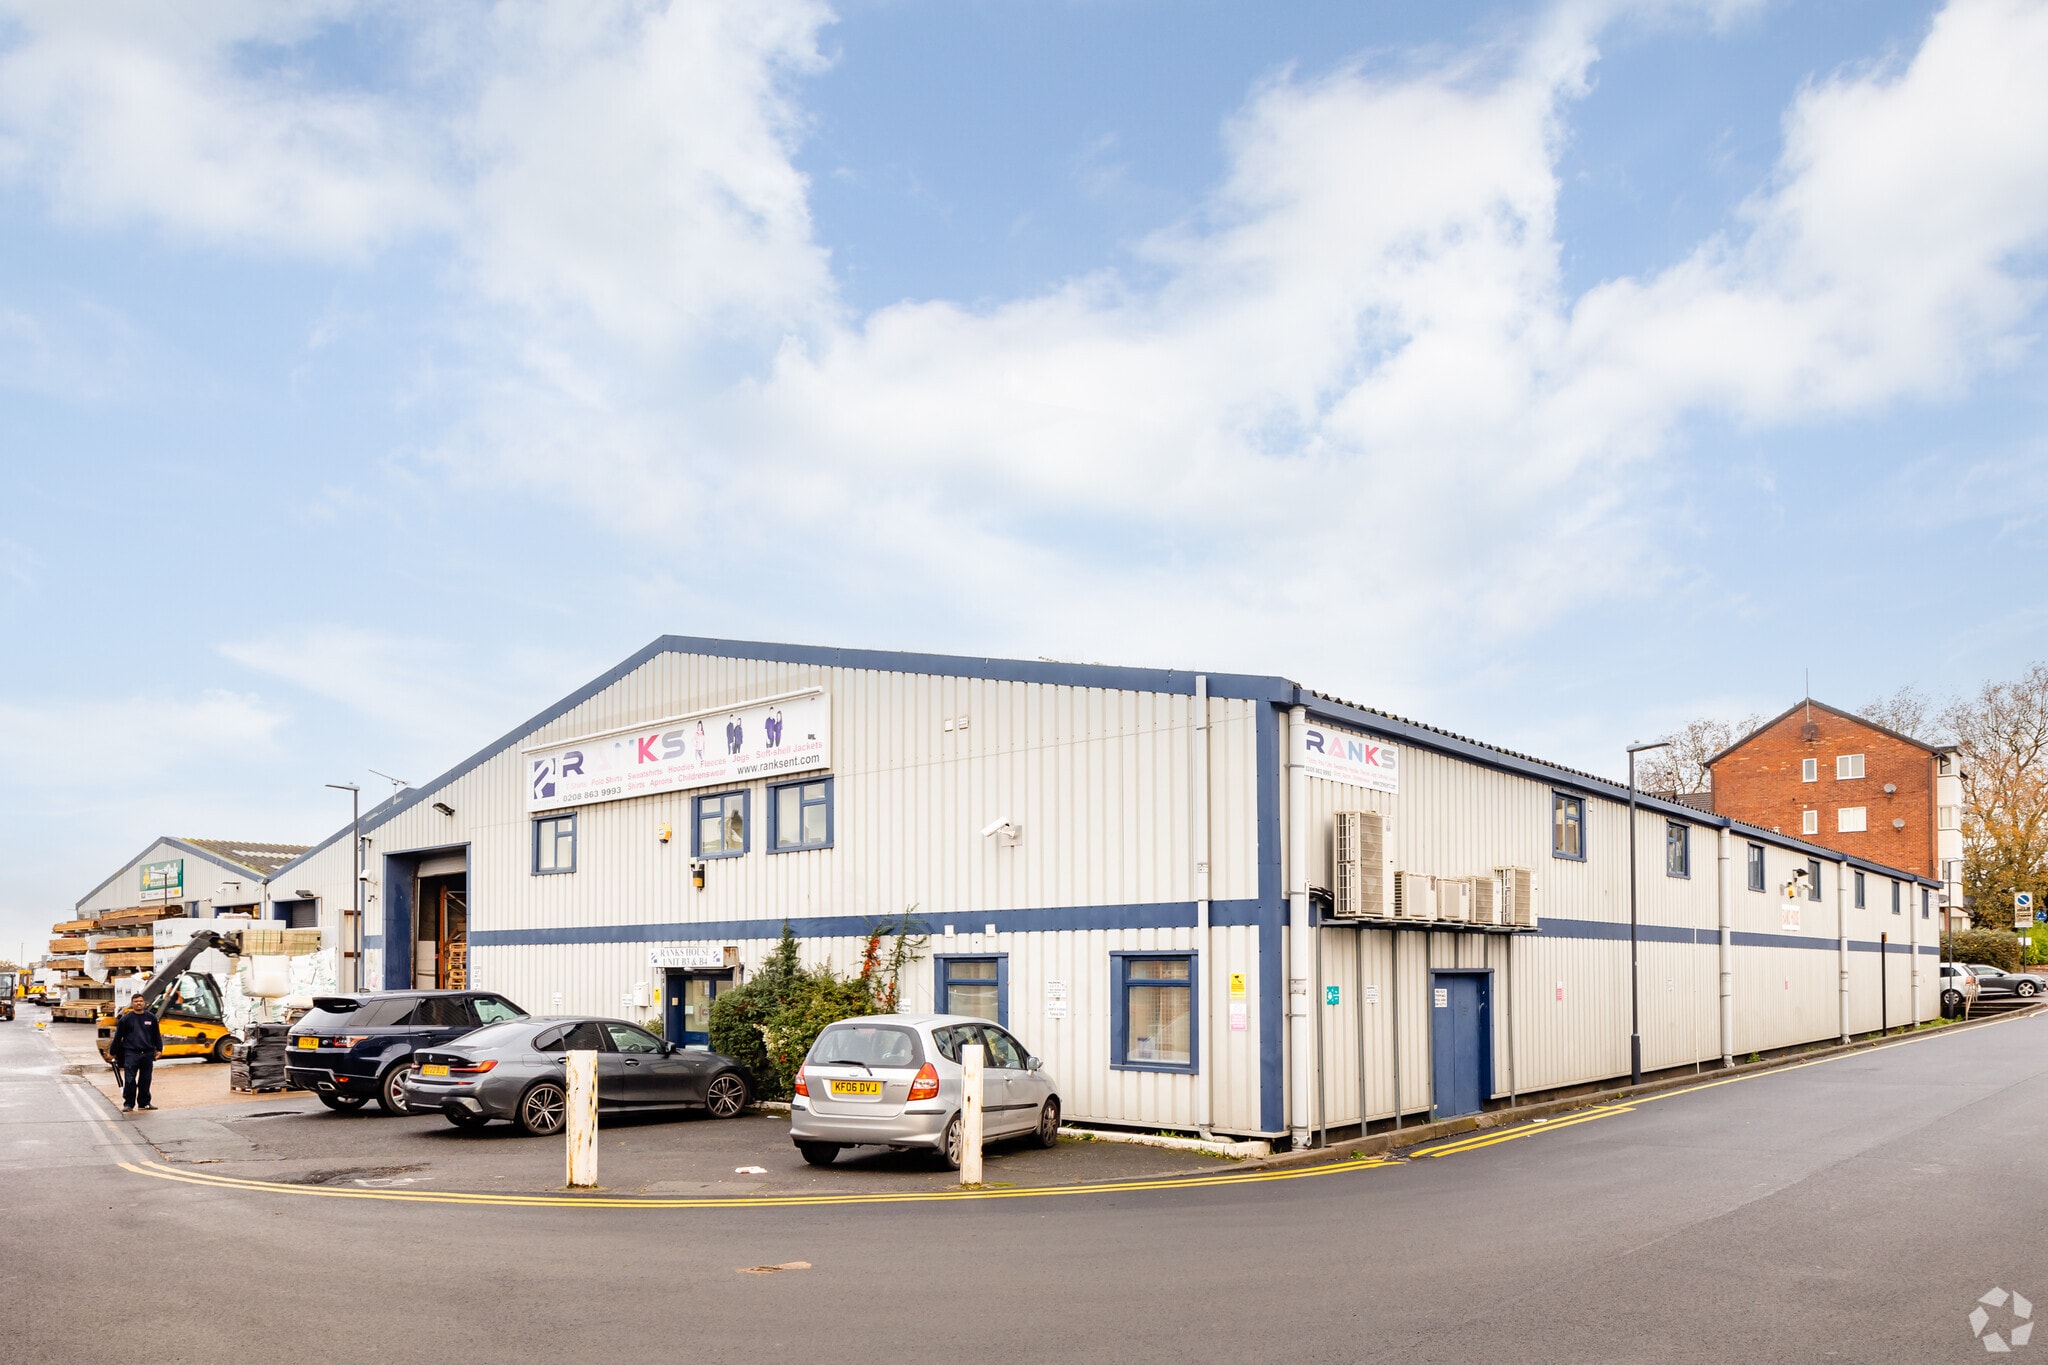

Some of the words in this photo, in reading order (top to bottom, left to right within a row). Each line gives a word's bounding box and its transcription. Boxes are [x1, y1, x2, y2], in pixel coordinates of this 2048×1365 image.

[562, 729, 686, 778] RKS
[1306, 730, 1396, 770] RANKS
[591, 778, 604, 786] Polo
[606, 776, 623, 784] Shirts
[627, 768, 663, 780] Sweatshirts
[668, 764, 695, 774] Hoodies
[700, 759, 727, 768] Fleeces
[732, 754, 750, 763] Jogs
[756, 747, 791, 759] Soft-shell
[793, 741, 823, 753] Jackets
[737, 754, 820, 775] www.ranksent.com
[628, 781, 645, 790] Shirts
[650, 777, 673, 787] Aprons
[678, 769, 726, 782] Childrenswear
[563, 793, 582, 802] 0208
[584, 790, 599, 799] 863
[601, 786, 622, 796] 9993
[660, 949, 685, 957] RANKS
[686, 948, 711, 957] HOUSE
[835, 1082, 857, 1092] KF06
[860, 1083, 877, 1093] DVJ
